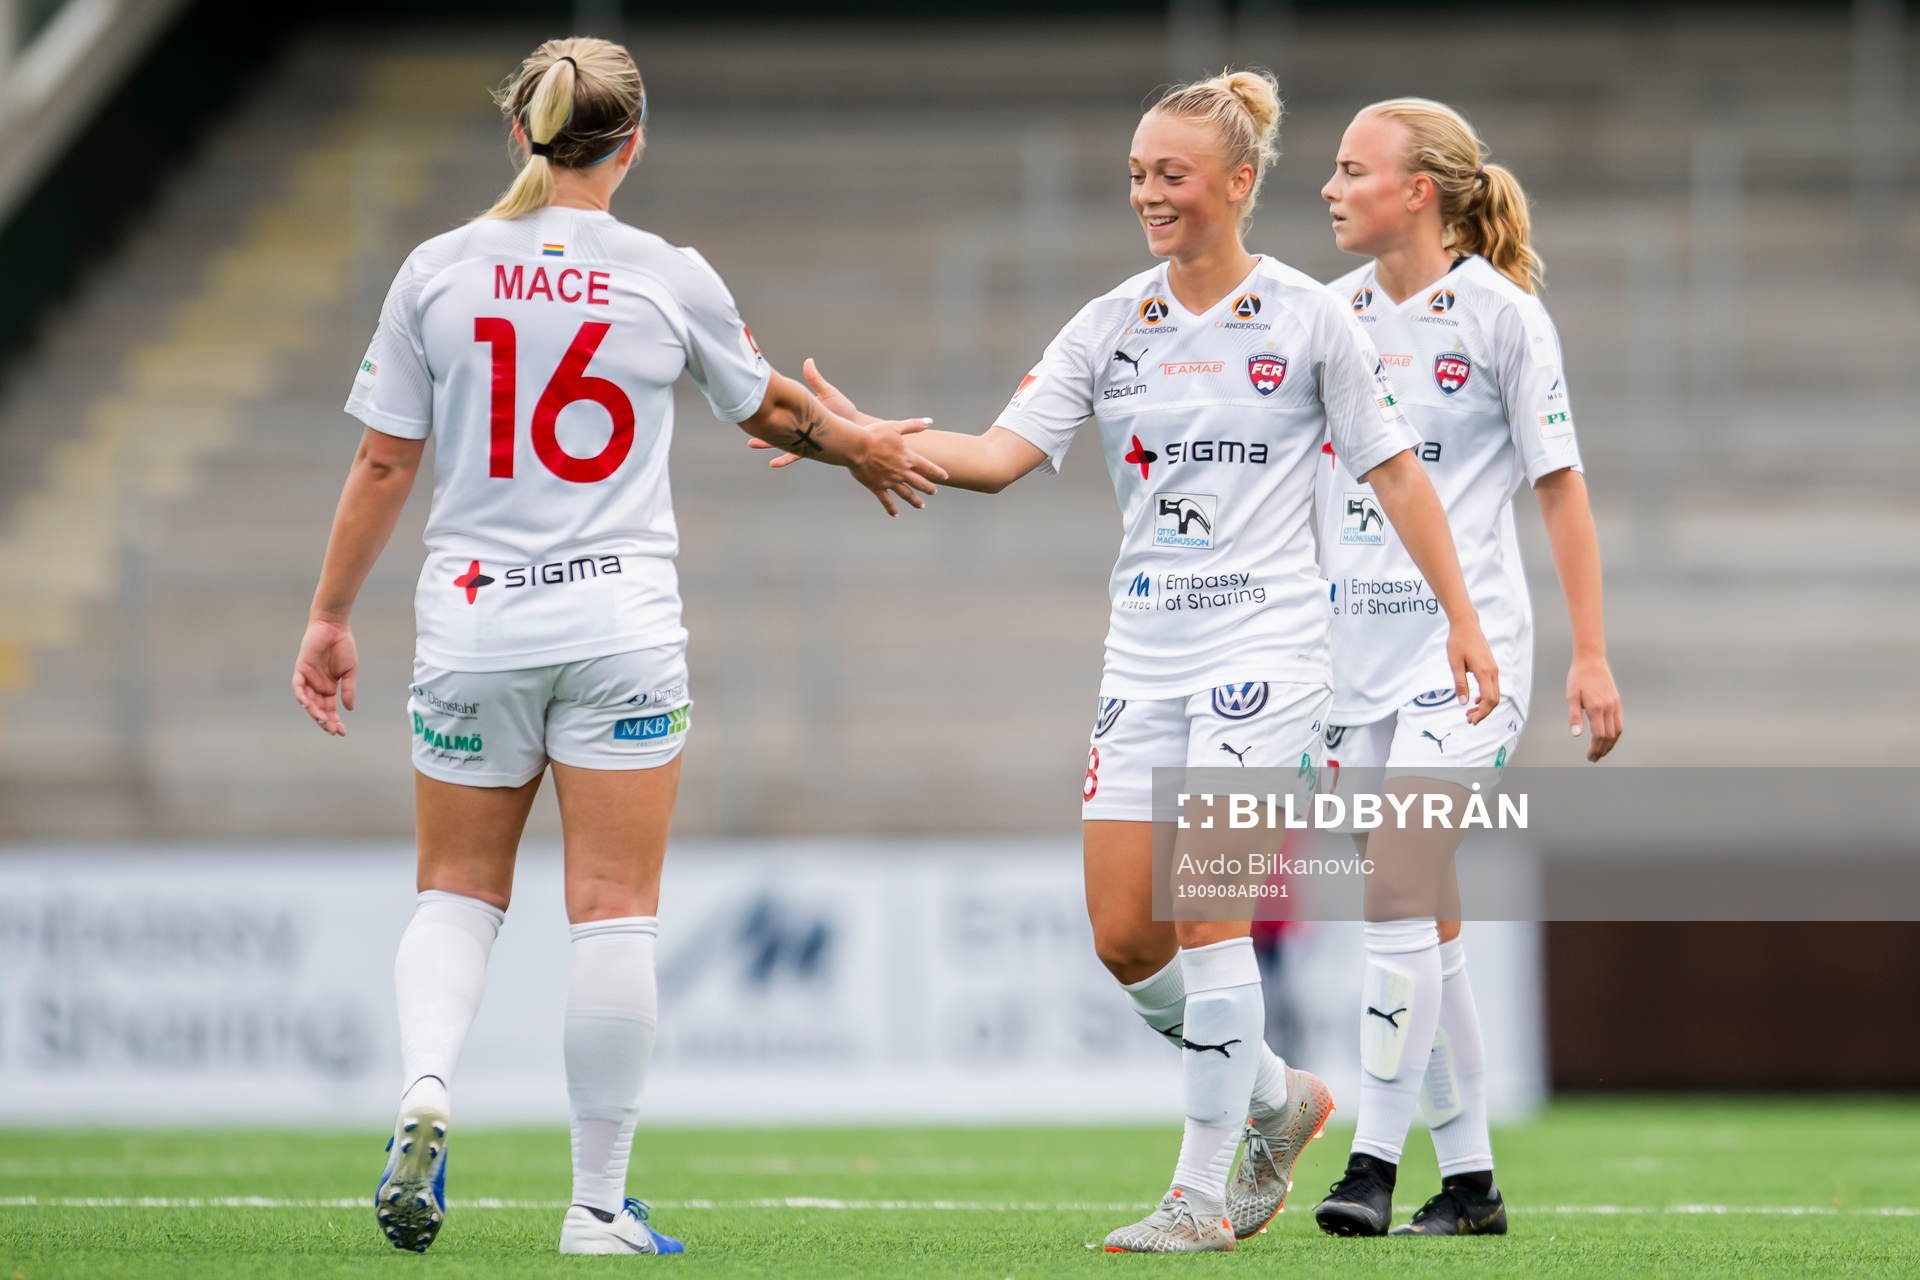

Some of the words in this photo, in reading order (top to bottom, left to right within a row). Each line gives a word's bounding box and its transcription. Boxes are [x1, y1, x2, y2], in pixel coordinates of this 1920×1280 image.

[494, 265, 610, 305] MACE
[1159, 361, 1225, 376] TEAMAB
[1251, 363, 1284, 377] FCR
[1382, 355, 1413, 367] MAB
[1437, 361, 1468, 378] FCR
[474, 317, 635, 483] 16
[1156, 536, 1209, 547] MAGNUSSON
[1166, 572, 1250, 591] Embassy
[1351, 578, 1423, 596] Embassy
[1165, 594, 1181, 611] of
[1187, 586, 1266, 610] Sharing
[1351, 598, 1365, 615] of
[1367, 596, 1439, 615] Sharing
[621, 716, 666, 737] MKB
[424, 727, 483, 753] MALMÖ
